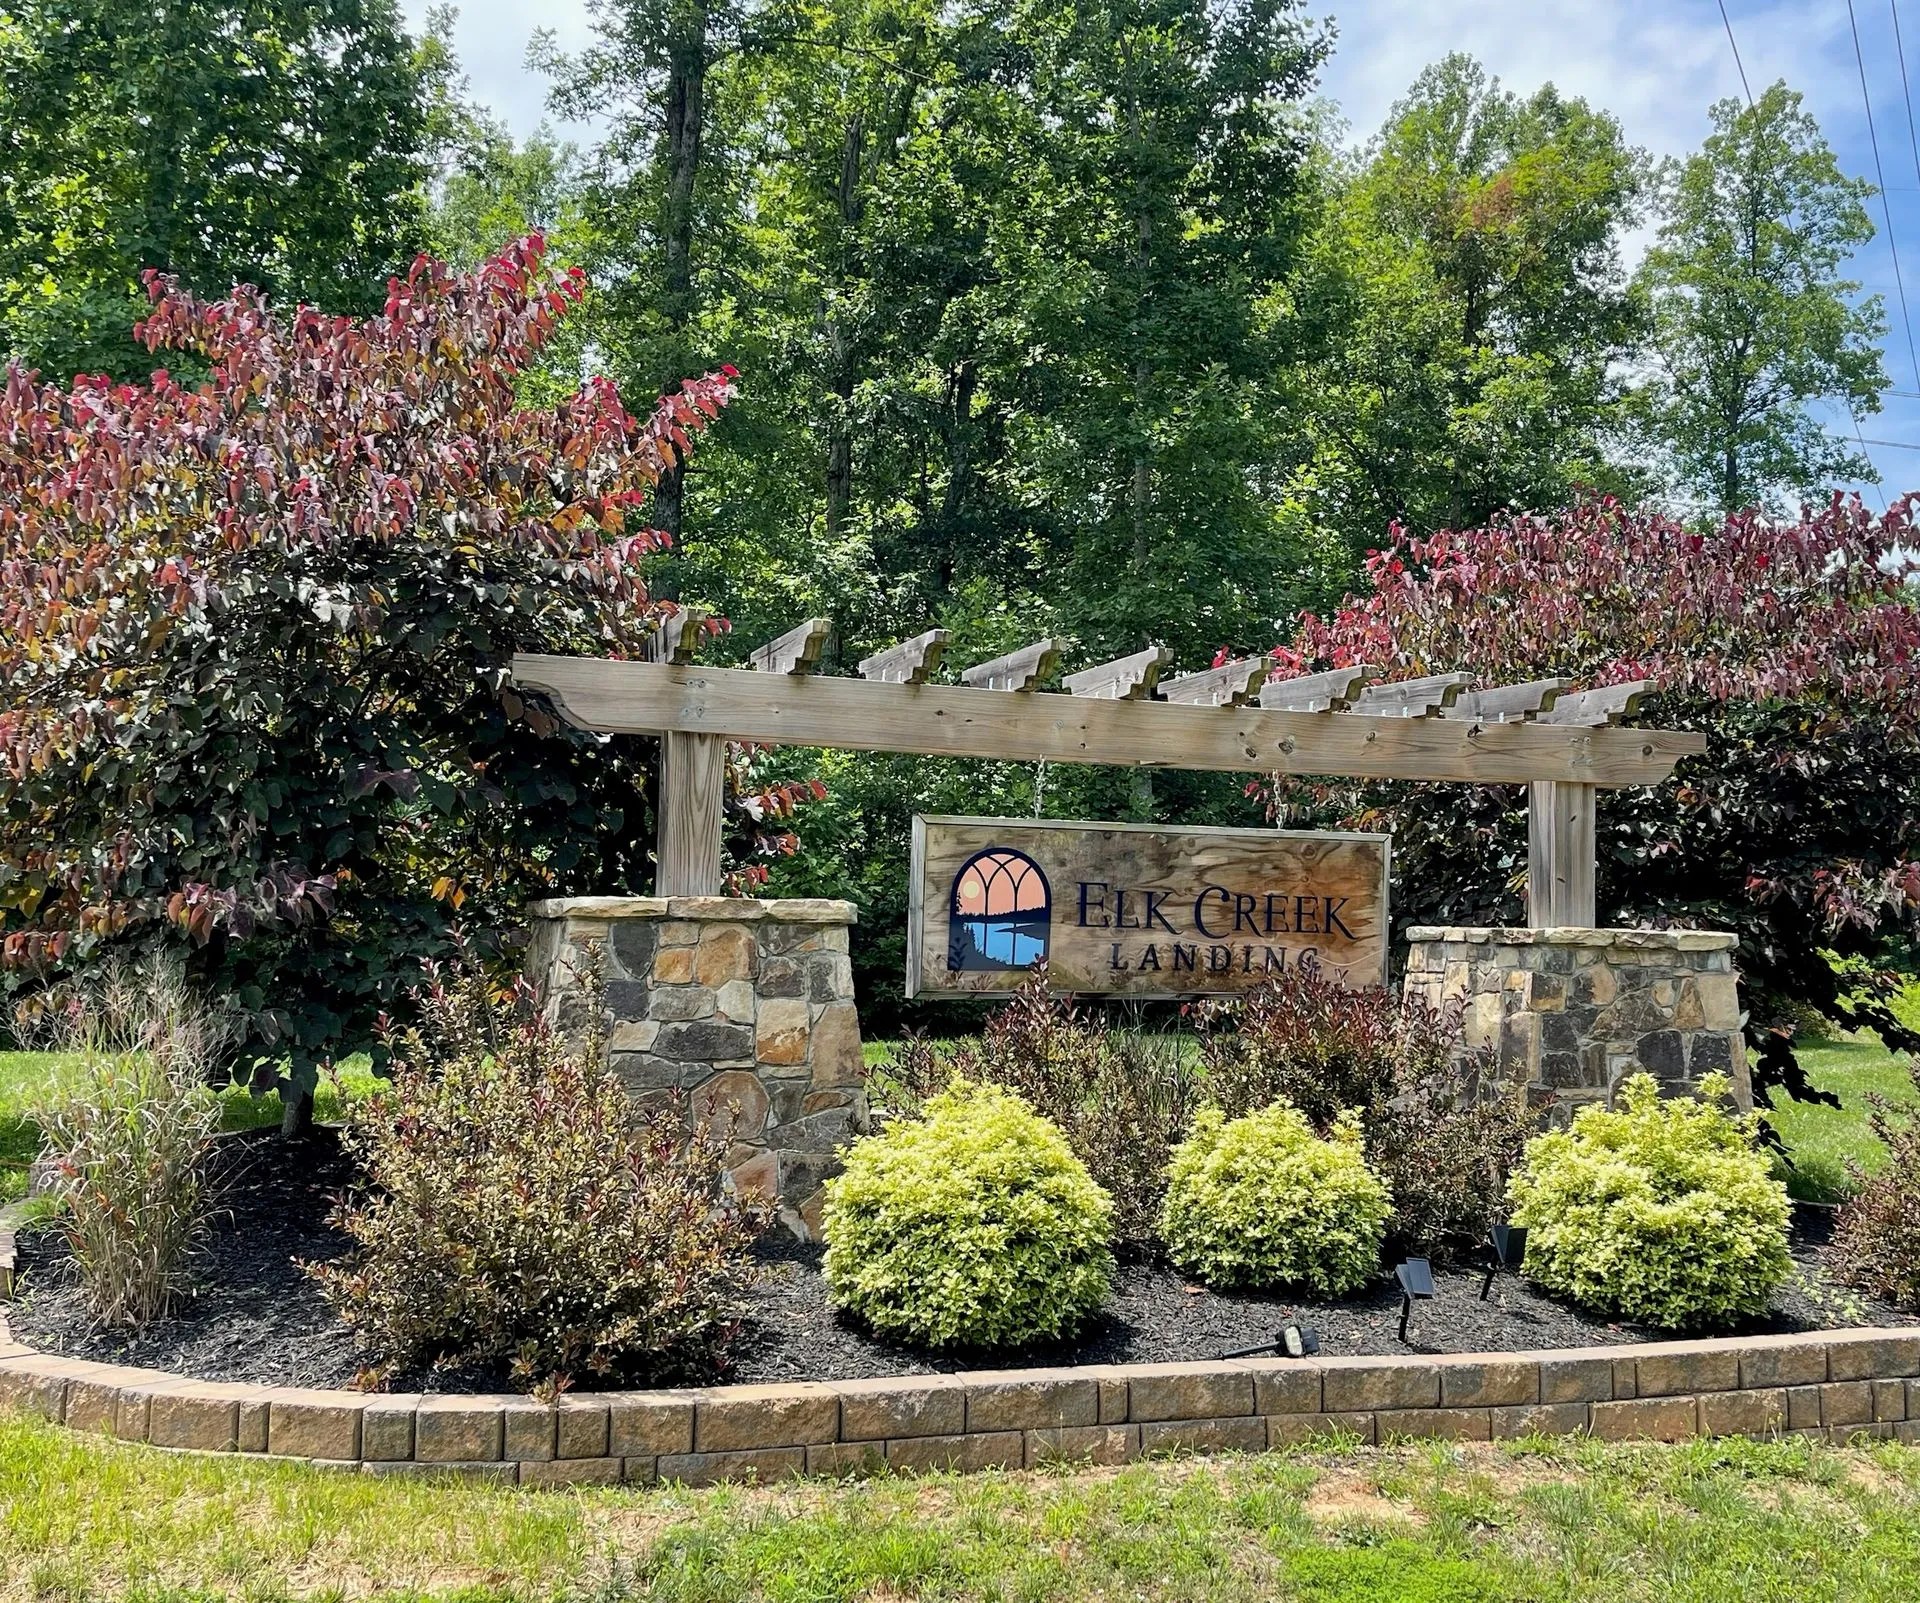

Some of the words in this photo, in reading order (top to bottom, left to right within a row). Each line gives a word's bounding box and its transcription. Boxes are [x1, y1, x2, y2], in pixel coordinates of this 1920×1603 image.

[1075, 881, 1184, 935] ELK
[1195, 886, 1360, 939] CREEK
[1109, 943, 1319, 975] LANDING
